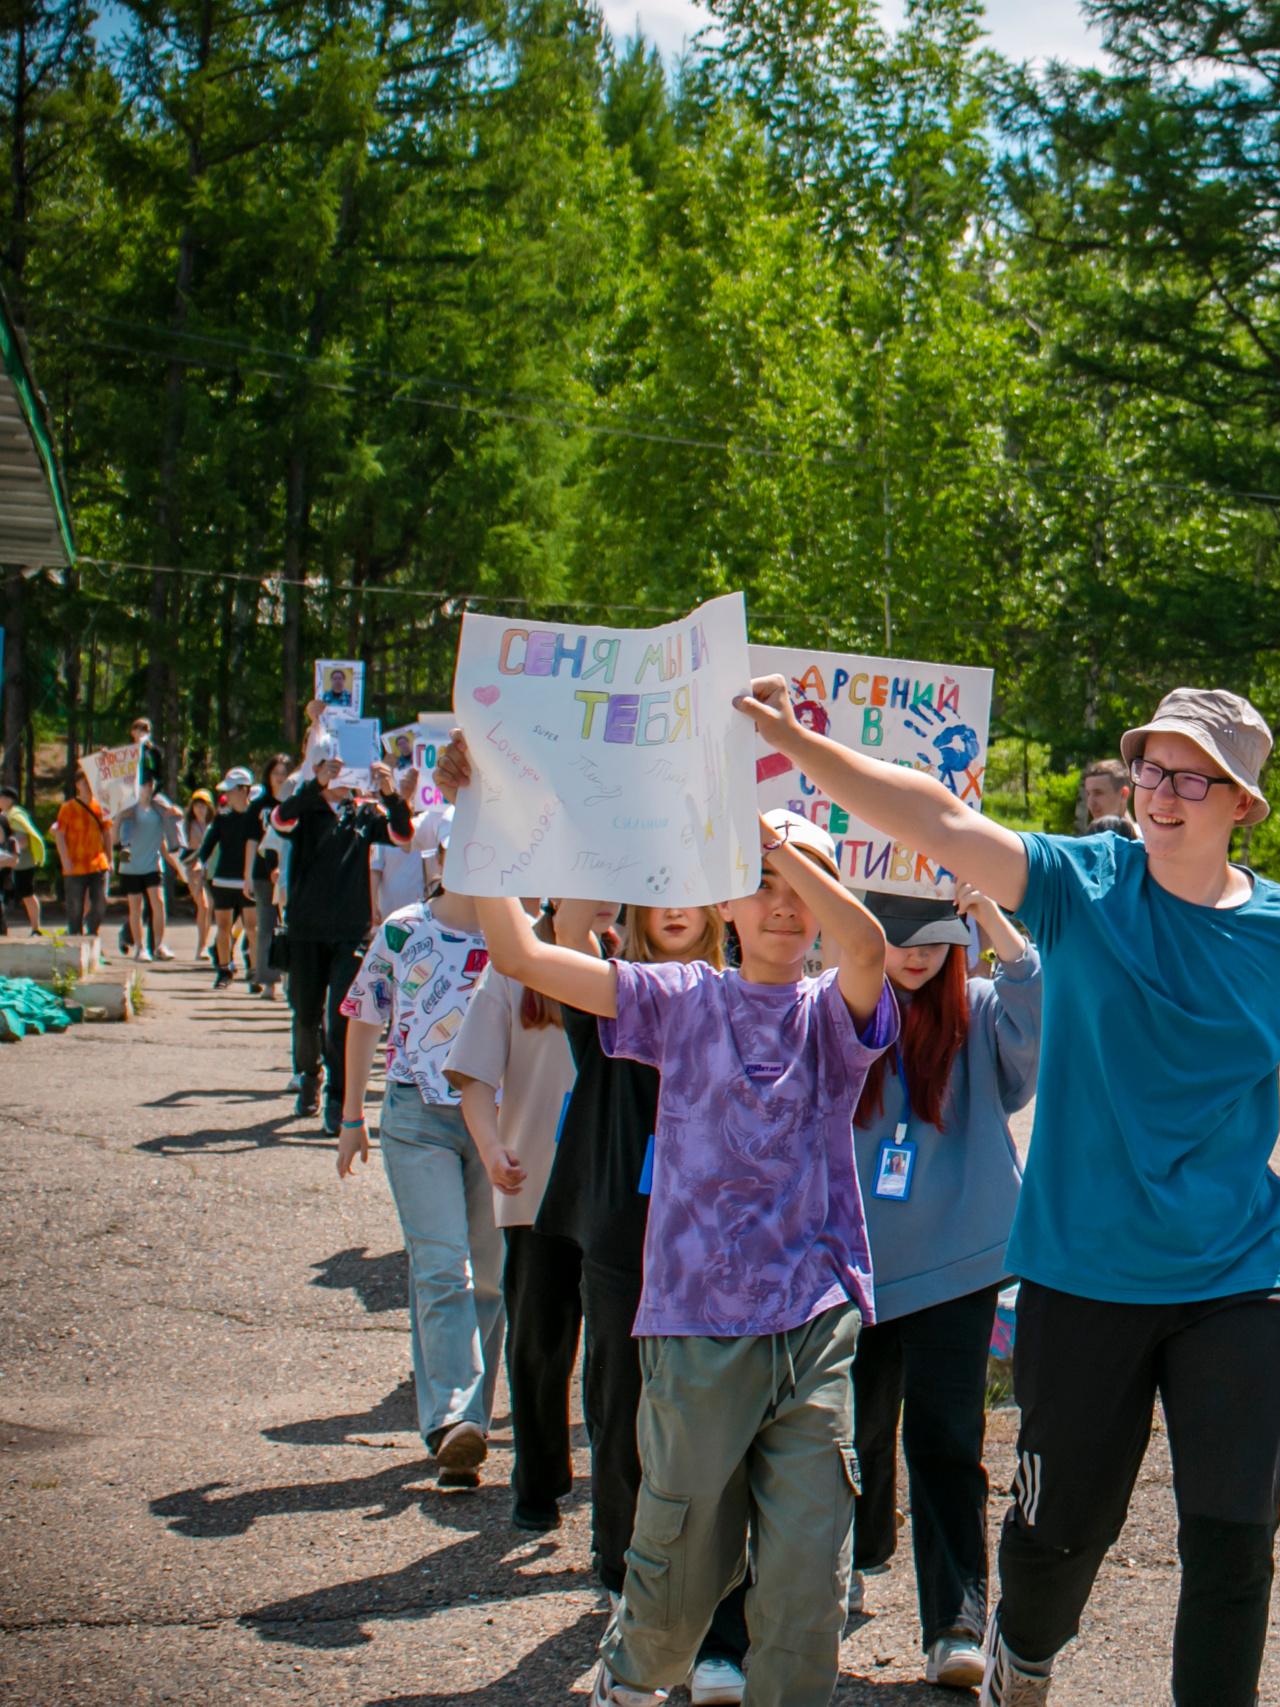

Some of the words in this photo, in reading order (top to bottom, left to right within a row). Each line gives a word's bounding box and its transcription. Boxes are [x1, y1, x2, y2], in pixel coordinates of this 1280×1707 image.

[498, 628, 622, 684] СЕНЯ
[635, 632, 683, 684] МЫ
[797, 665, 960, 714] АРСЕНИЙ
[533, 725, 559, 742] SUPER
[574, 678, 700, 747] ТЕБЯ!
[861, 707, 883, 746] В
[416, 744, 446, 769] ГО
[486, 720, 521, 765] Love
[518, 763, 541, 782] you
[421, 786, 448, 805] СА
